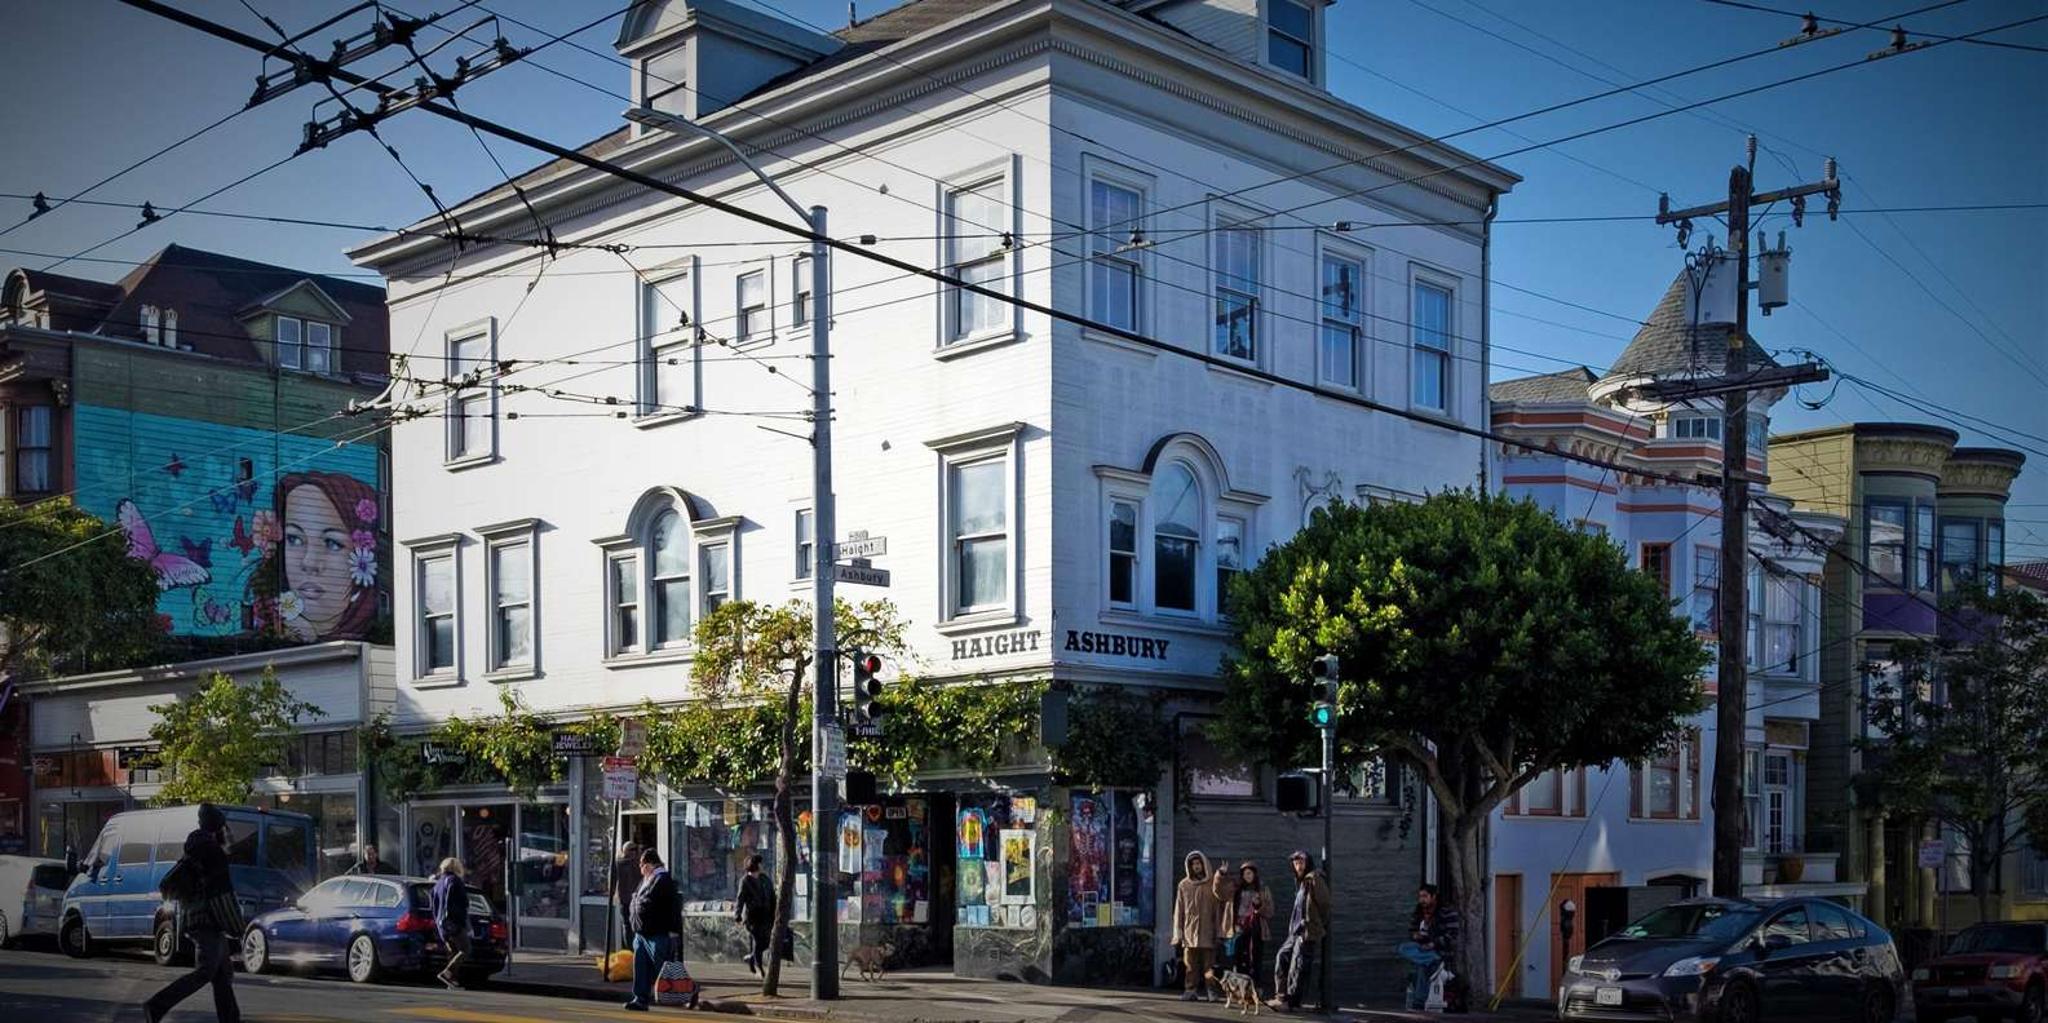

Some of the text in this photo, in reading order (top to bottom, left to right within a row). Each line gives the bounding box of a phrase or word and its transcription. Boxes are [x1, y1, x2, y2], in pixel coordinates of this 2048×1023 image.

[841, 541, 874, 556] Haight
[840, 568, 884, 585] Ashbury
[951, 630, 1041, 660] HAIGHT
[1064, 630, 1171, 660] ASHBURY
